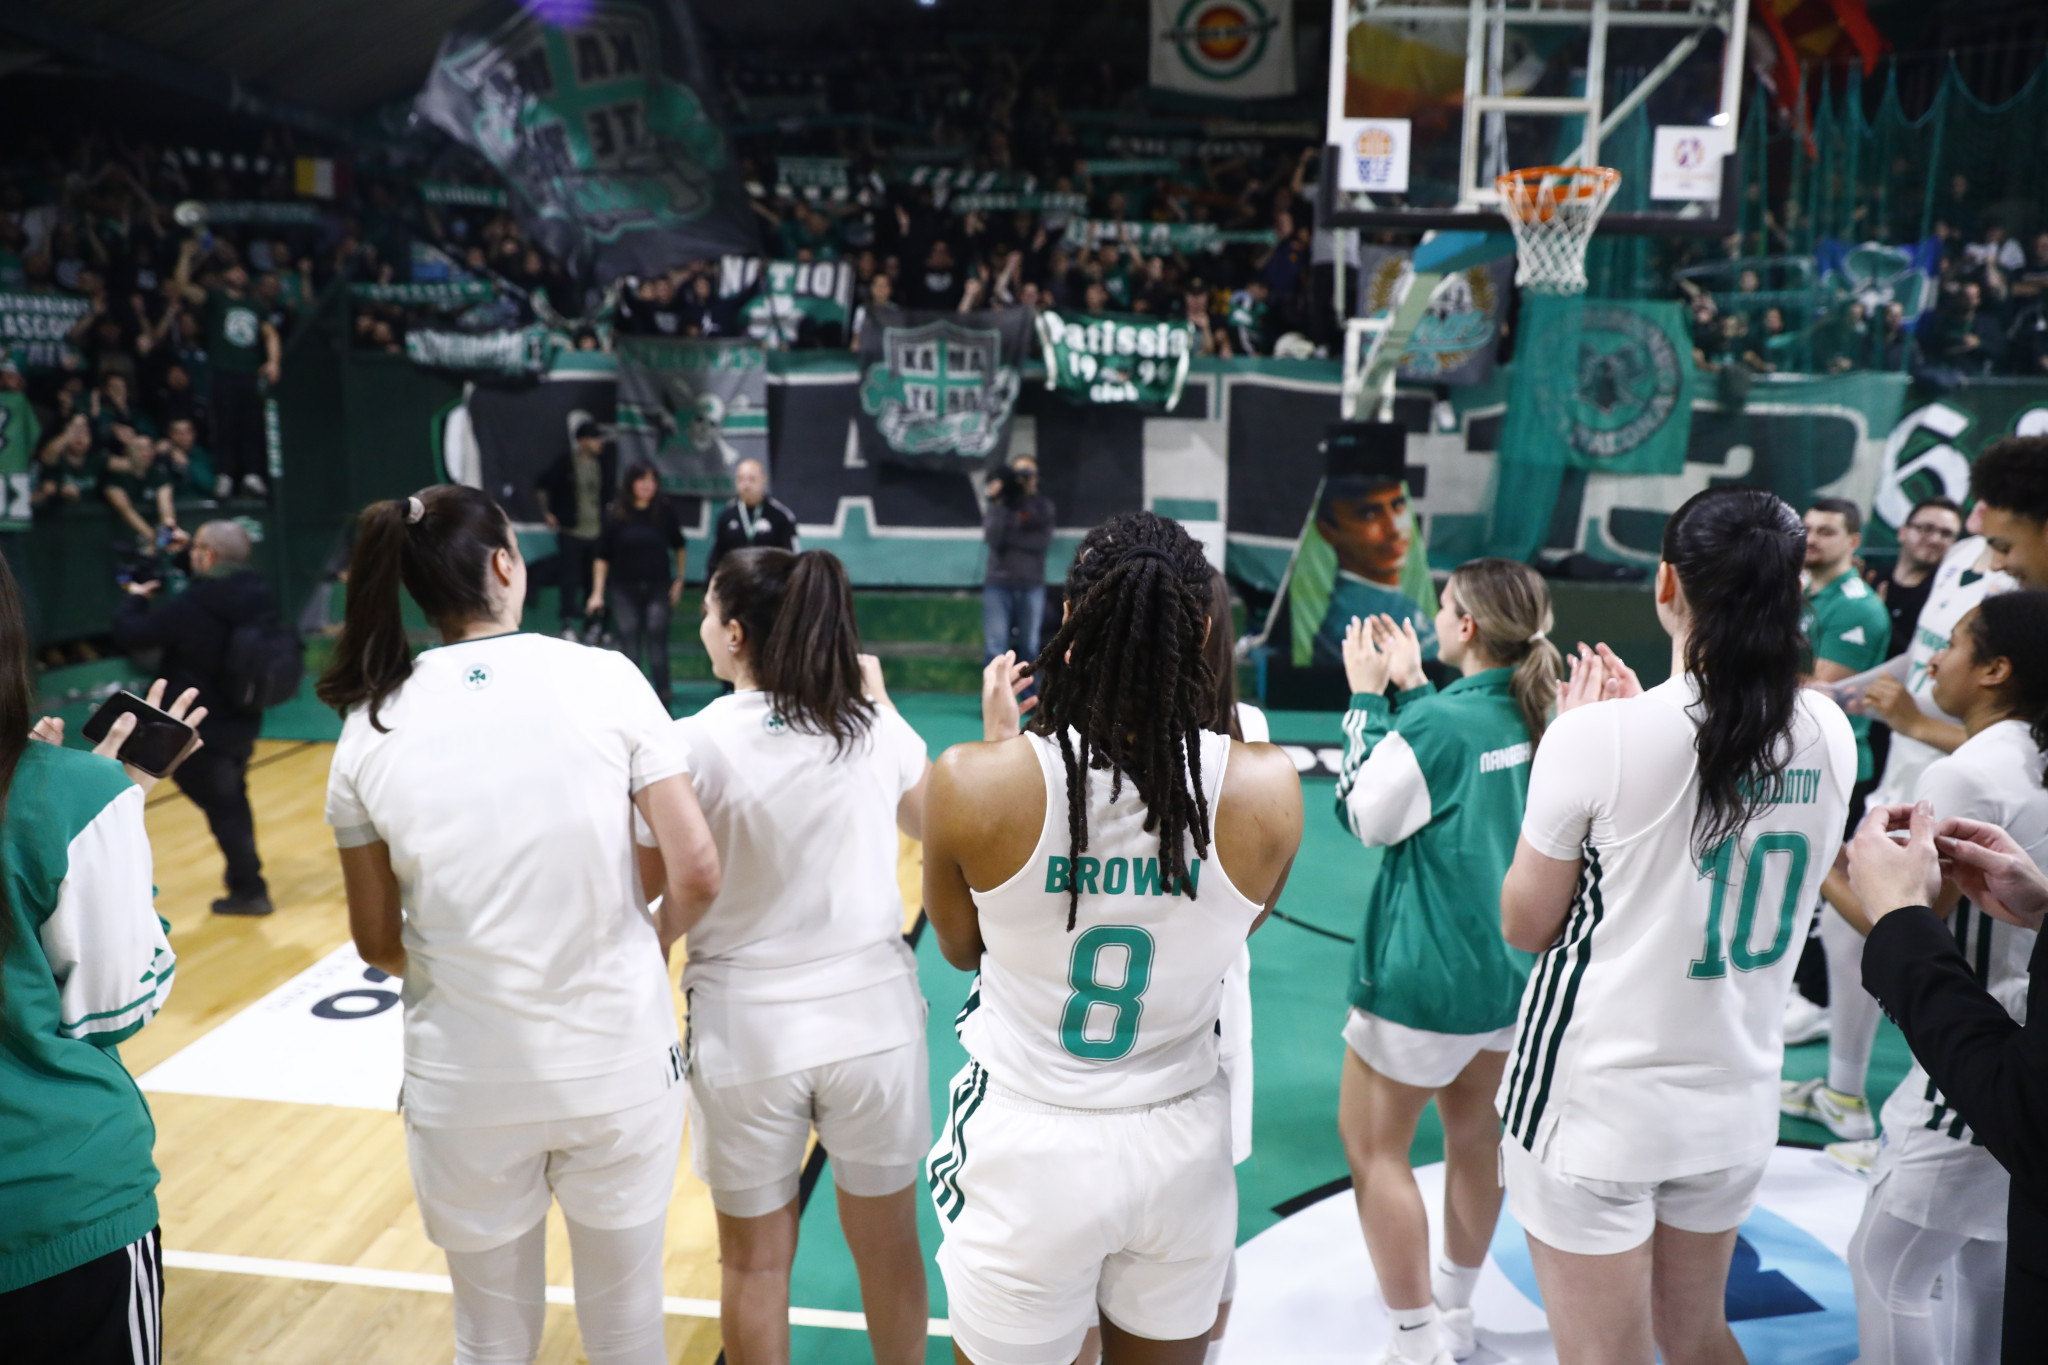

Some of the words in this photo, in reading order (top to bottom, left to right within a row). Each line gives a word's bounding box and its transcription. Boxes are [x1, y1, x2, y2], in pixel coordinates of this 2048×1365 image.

[1045, 856, 1200, 896] BROWN
[1687, 831, 1810, 979] 10
[1059, 925, 1155, 1062] 8
